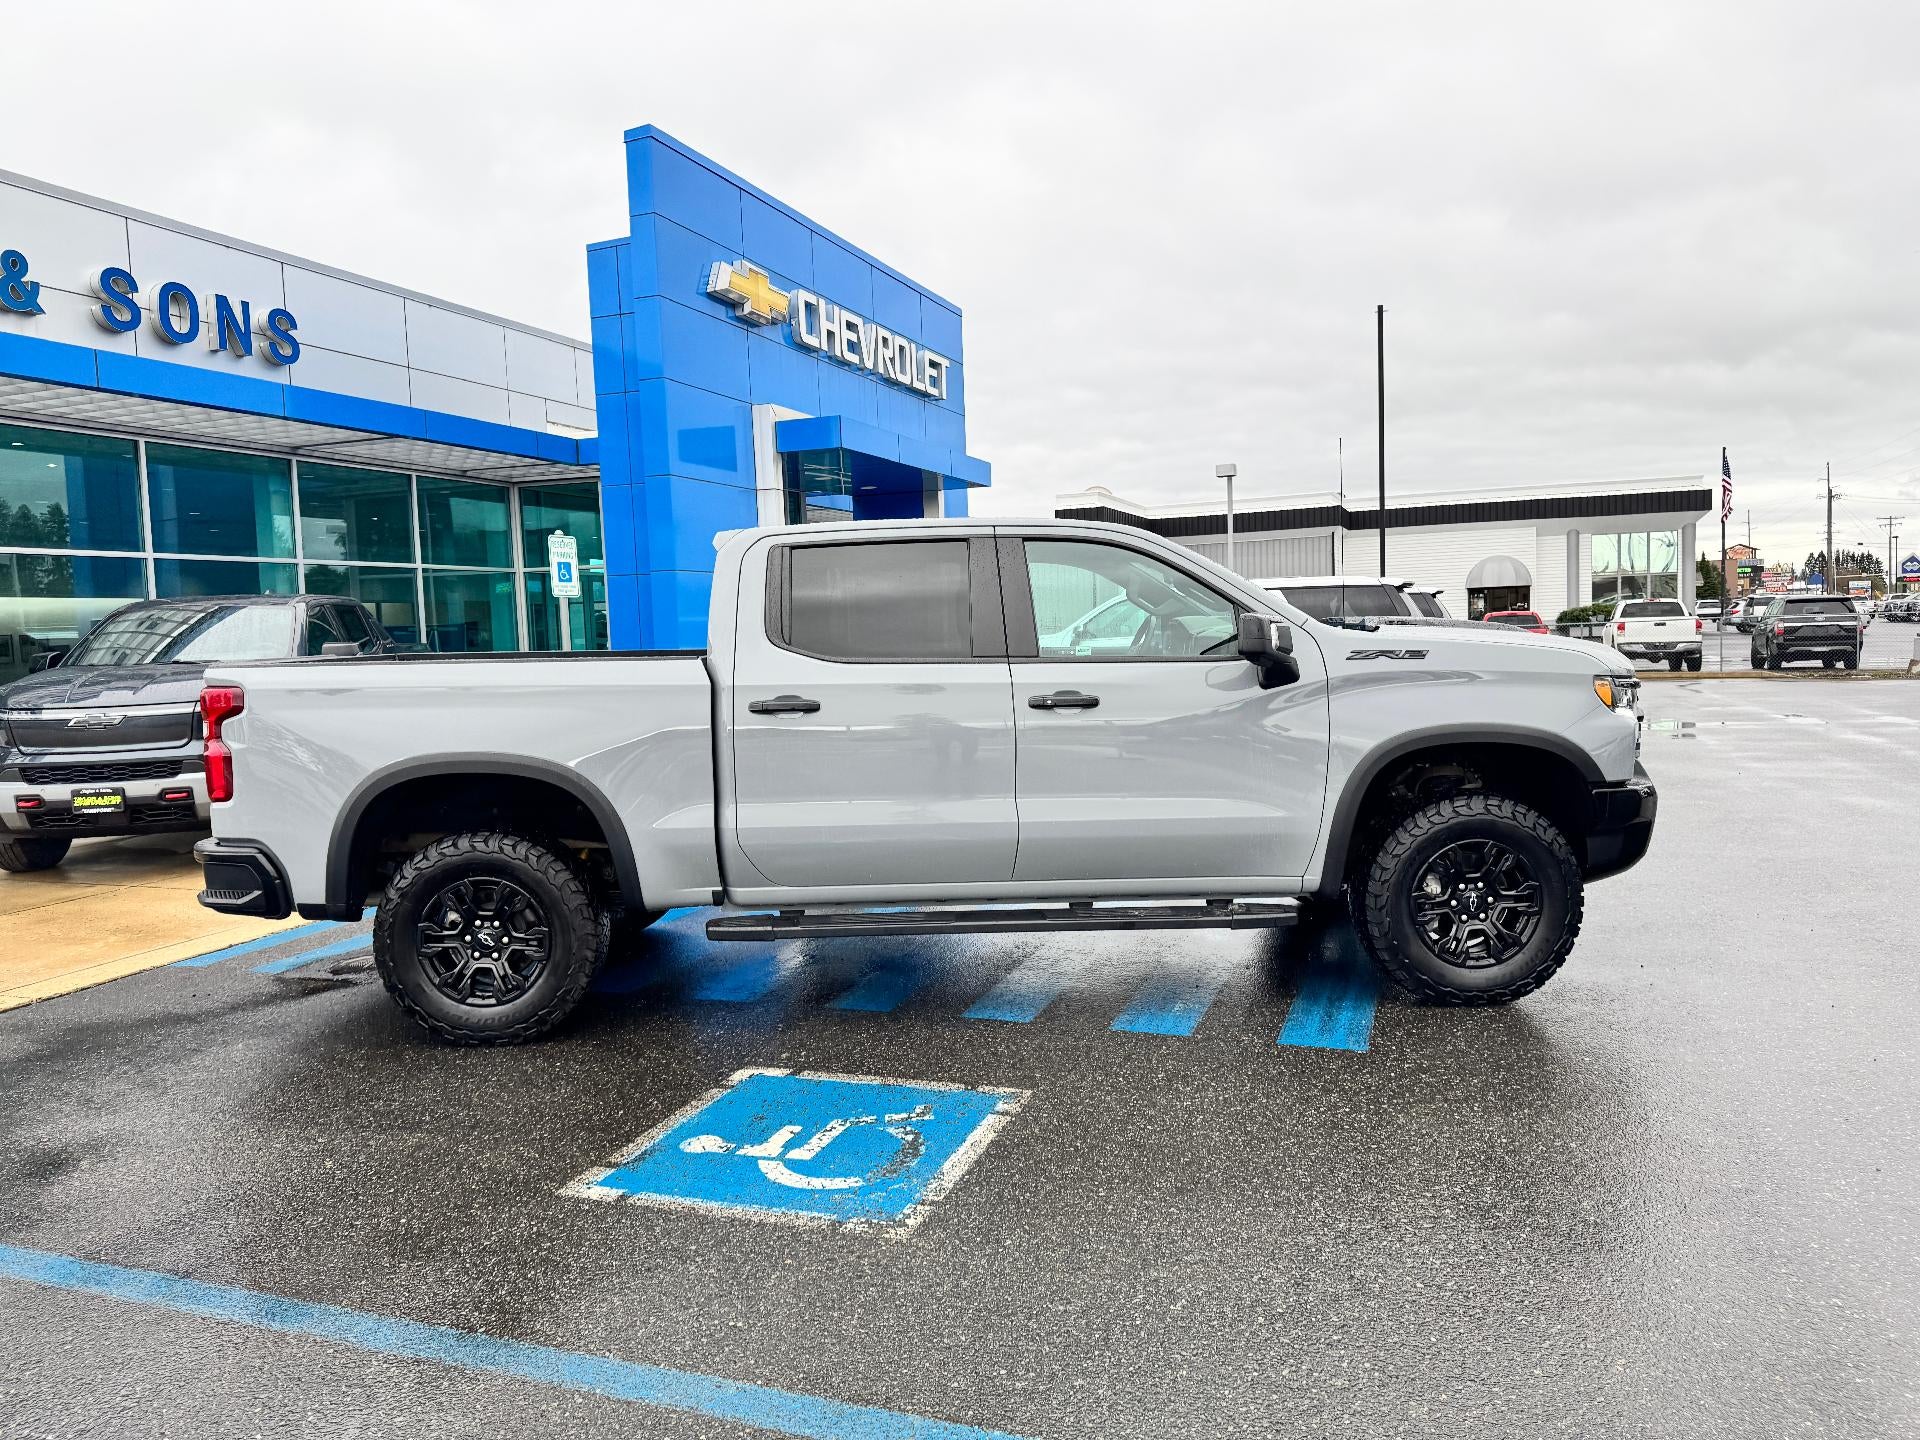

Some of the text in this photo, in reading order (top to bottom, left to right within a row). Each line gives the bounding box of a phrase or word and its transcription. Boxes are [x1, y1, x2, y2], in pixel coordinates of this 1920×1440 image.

[0, 249, 302, 366] & SONS
[790, 289, 950, 401] CHEVROLET
[1345, 649, 1430, 660] ZR2
